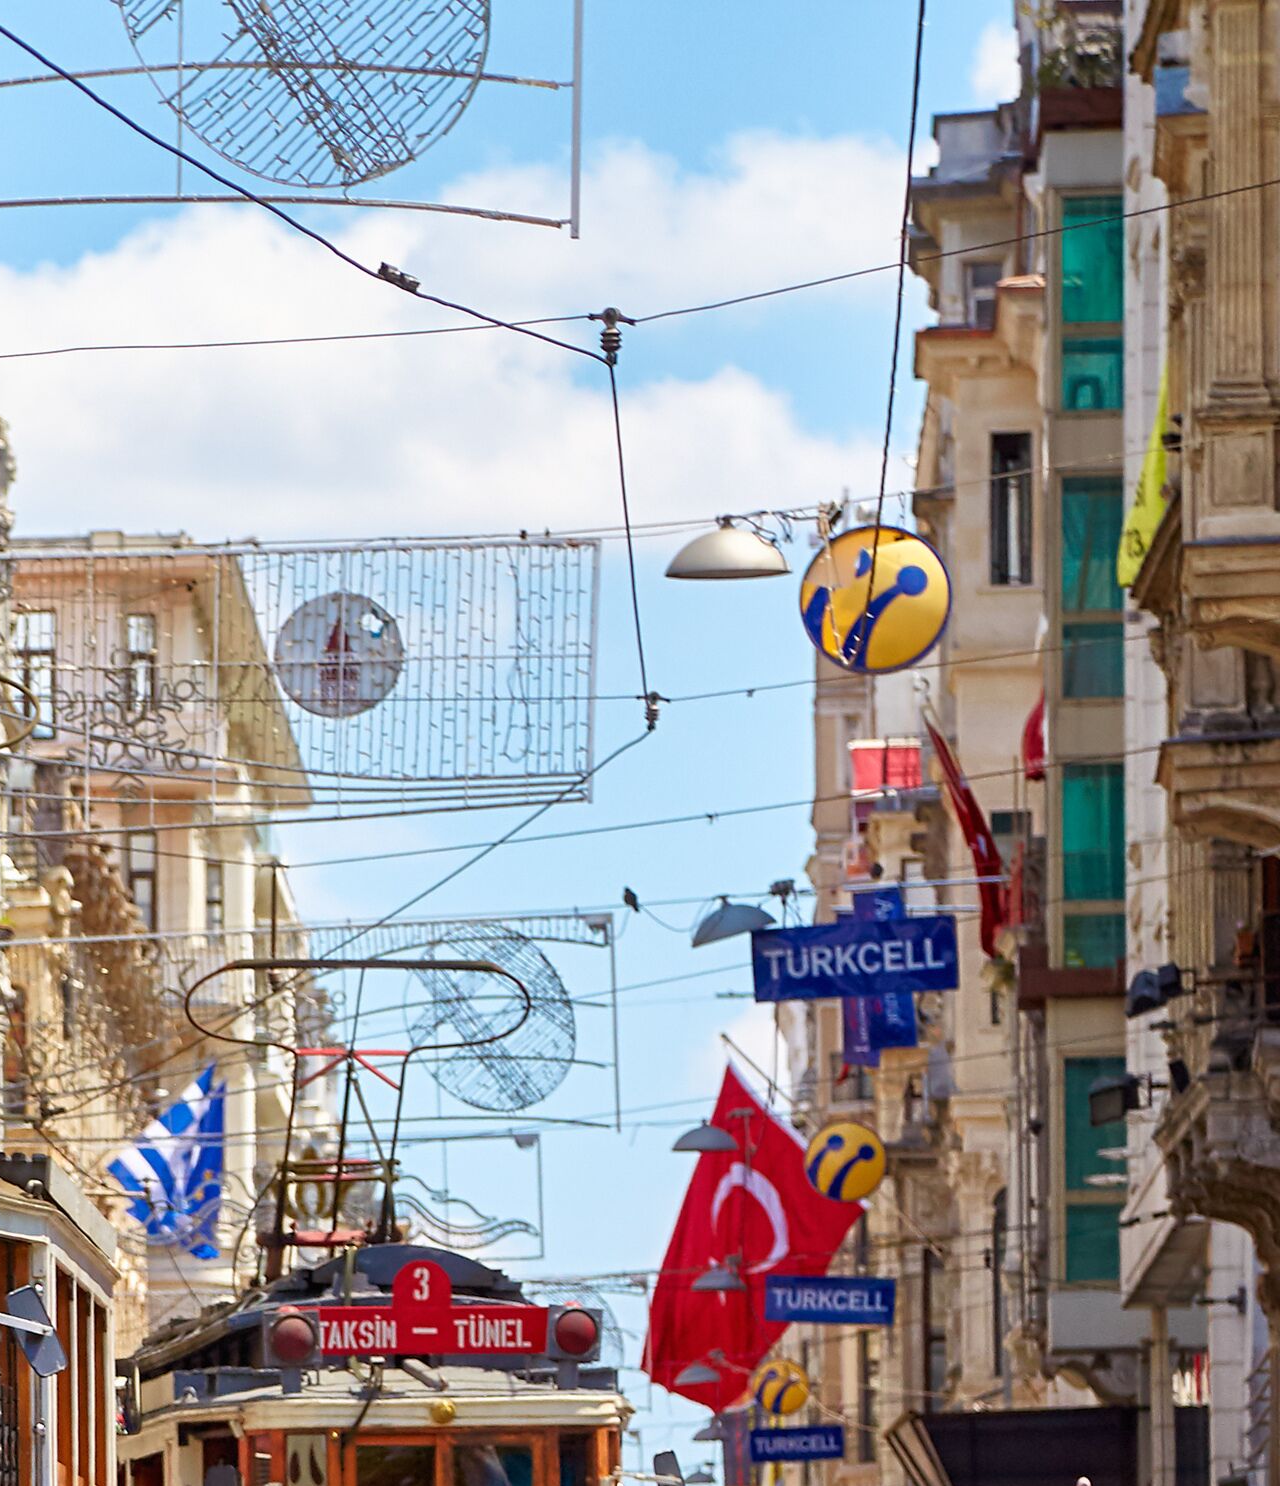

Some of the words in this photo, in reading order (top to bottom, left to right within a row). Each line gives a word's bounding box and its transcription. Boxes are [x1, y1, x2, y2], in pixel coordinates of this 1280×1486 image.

[762, 937, 946, 981] TURKCELL
[413, 1268, 430, 1300] 3
[772, 1286, 889, 1313] TURKCELL
[454, 1314, 532, 1348] TÜNEL
[754, 1433, 840, 1454] TURKCELL
